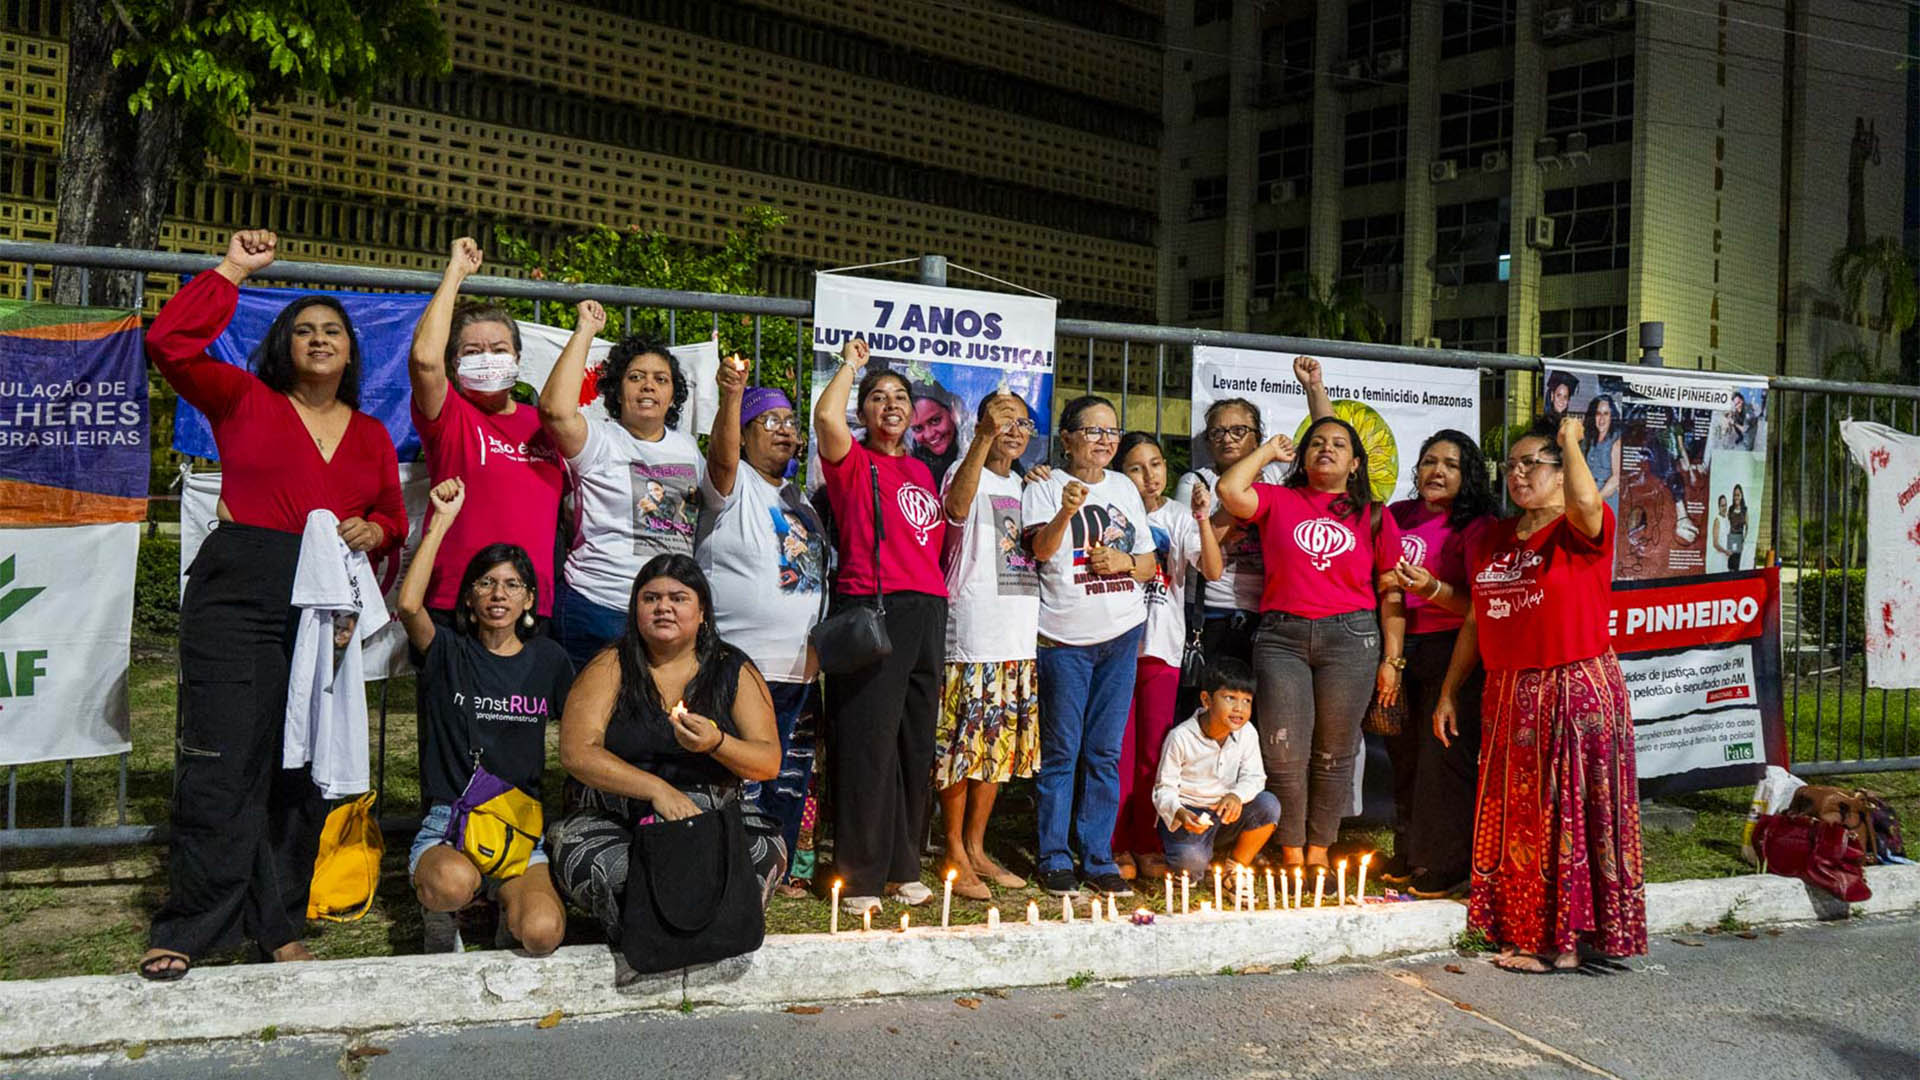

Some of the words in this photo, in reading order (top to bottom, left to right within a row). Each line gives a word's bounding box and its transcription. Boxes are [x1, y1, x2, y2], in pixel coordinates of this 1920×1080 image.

[873, 300, 894, 328] 7
[900, 304, 1003, 340] ANOS
[919, 338, 961, 357] POR
[965, 342, 1053, 370] JUSTIÇA!
[98, 381, 126, 396] DE
[1212, 374, 1257, 391] Levante
[1353, 388, 1360, 399] o
[1422, 391, 1473, 408] Amazonas
[1681, 389, 1728, 404] PINHEIRO
[1298, 521, 1345, 553] UBM
[1626, 596, 1759, 635] PINHEIRO
[1648, 668, 1661, 680] de
[1661, 665, 1699, 682] justiça,
[1732, 657, 1745, 669] PM
[1634, 684, 1673, 701] pelotão
[1674, 681, 1681, 693] é
[1731, 673, 1746, 685] AM
